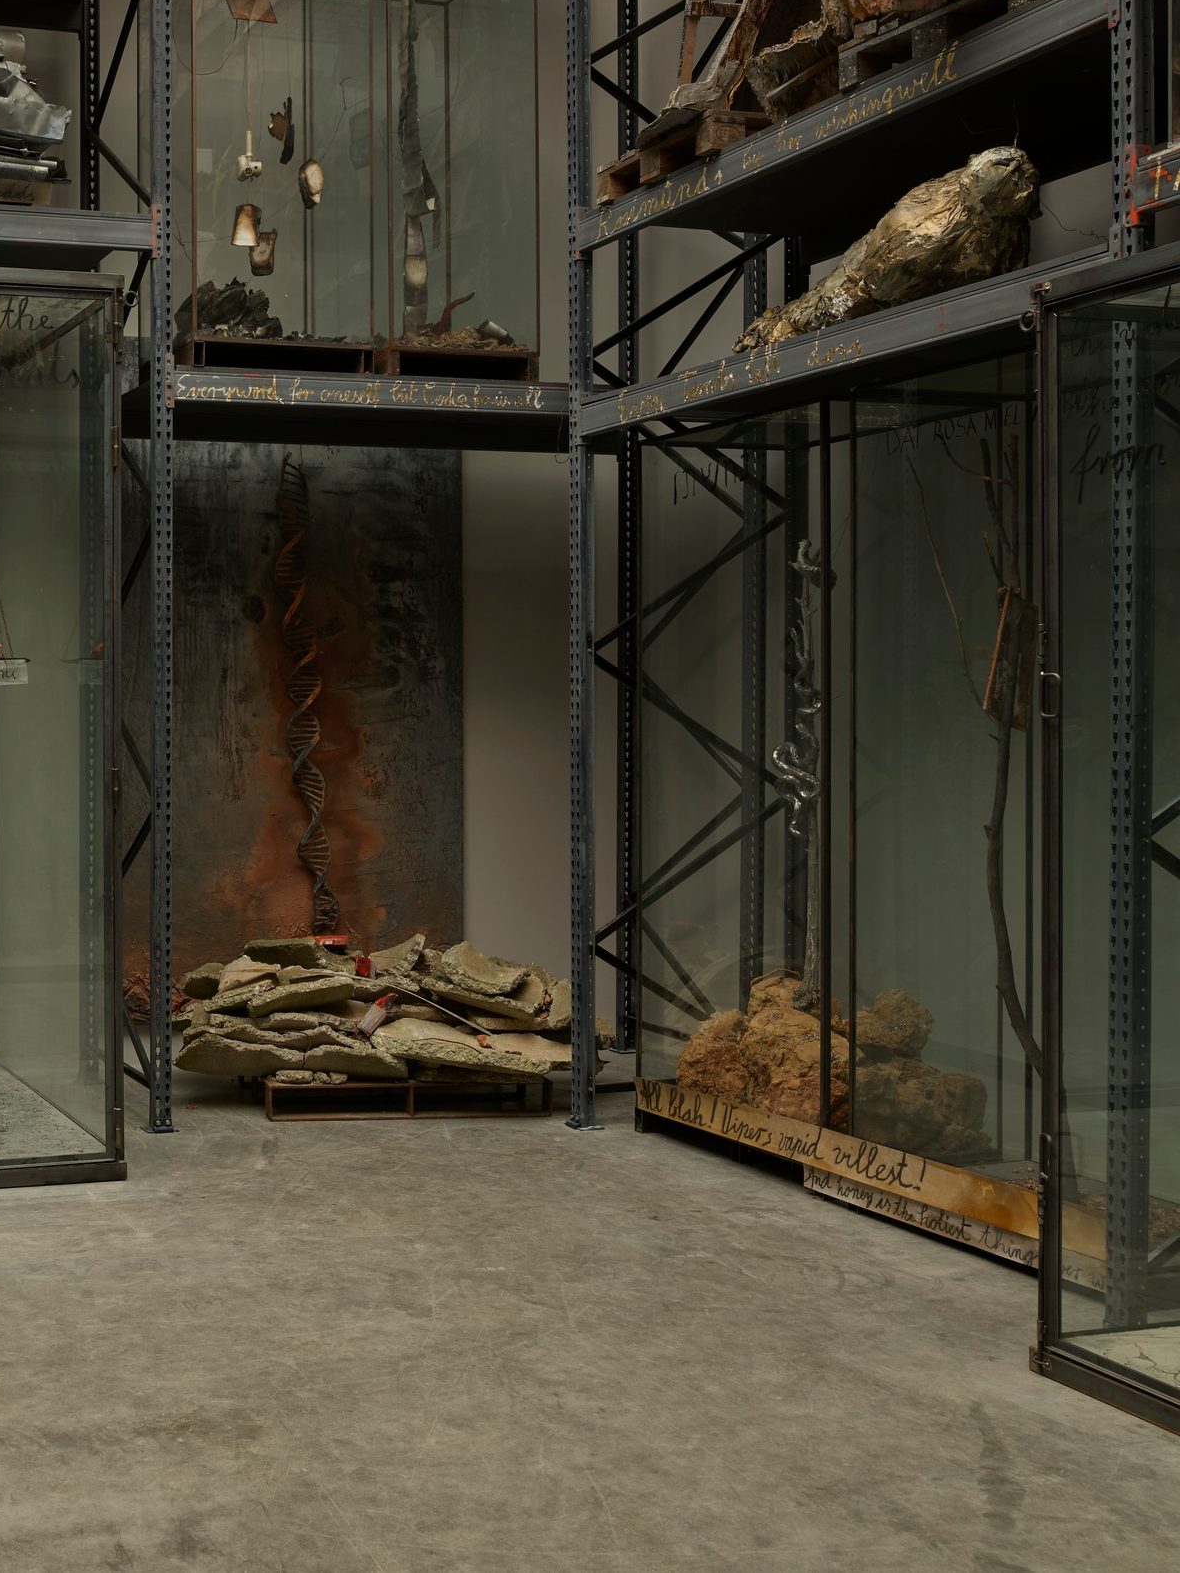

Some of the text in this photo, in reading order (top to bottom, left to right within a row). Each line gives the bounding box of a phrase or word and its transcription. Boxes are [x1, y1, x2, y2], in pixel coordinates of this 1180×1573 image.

[515, 385, 545, 409] all
[932, 415, 978, 443] ROSA
[639, 1078, 663, 1112] All
[806, 1165, 832, 1189] And
[837, 1175, 873, 1208] honey
[876, 1191, 892, 1213] is
[893, 1196, 918, 1223] the
[980, 1224, 1038, 1267] thing
